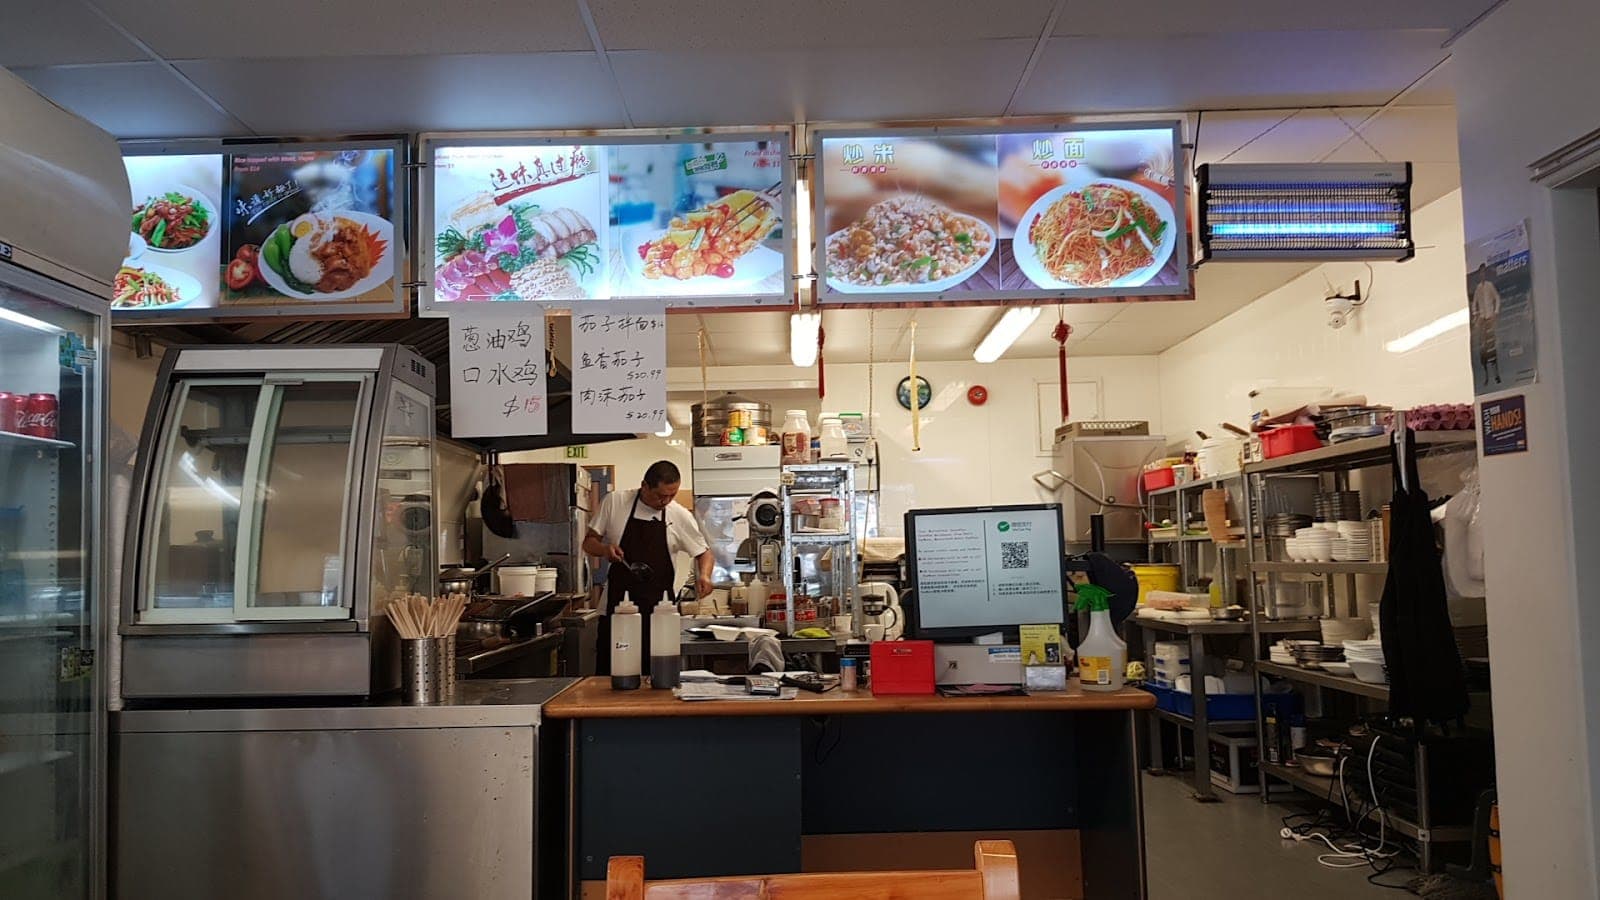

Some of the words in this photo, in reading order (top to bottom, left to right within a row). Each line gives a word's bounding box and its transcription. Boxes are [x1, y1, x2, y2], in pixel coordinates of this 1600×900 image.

[843, 144, 895, 165] 炒米
[1032, 138, 1085, 160] 炒面
[1496, 255, 1528, 276] matters
[461, 321, 532, 352] 葱油鸡
[580, 347, 644, 369] 鱼香茄子
[462, 360, 538, 386] 口水鸡
[626, 369, 662, 380] $20.99
[503, 395, 542, 418] $15
[1483, 409, 1491, 435] WASH
[1491, 408, 1522, 431] HANDS!
[568, 447, 585, 458] EXIT
